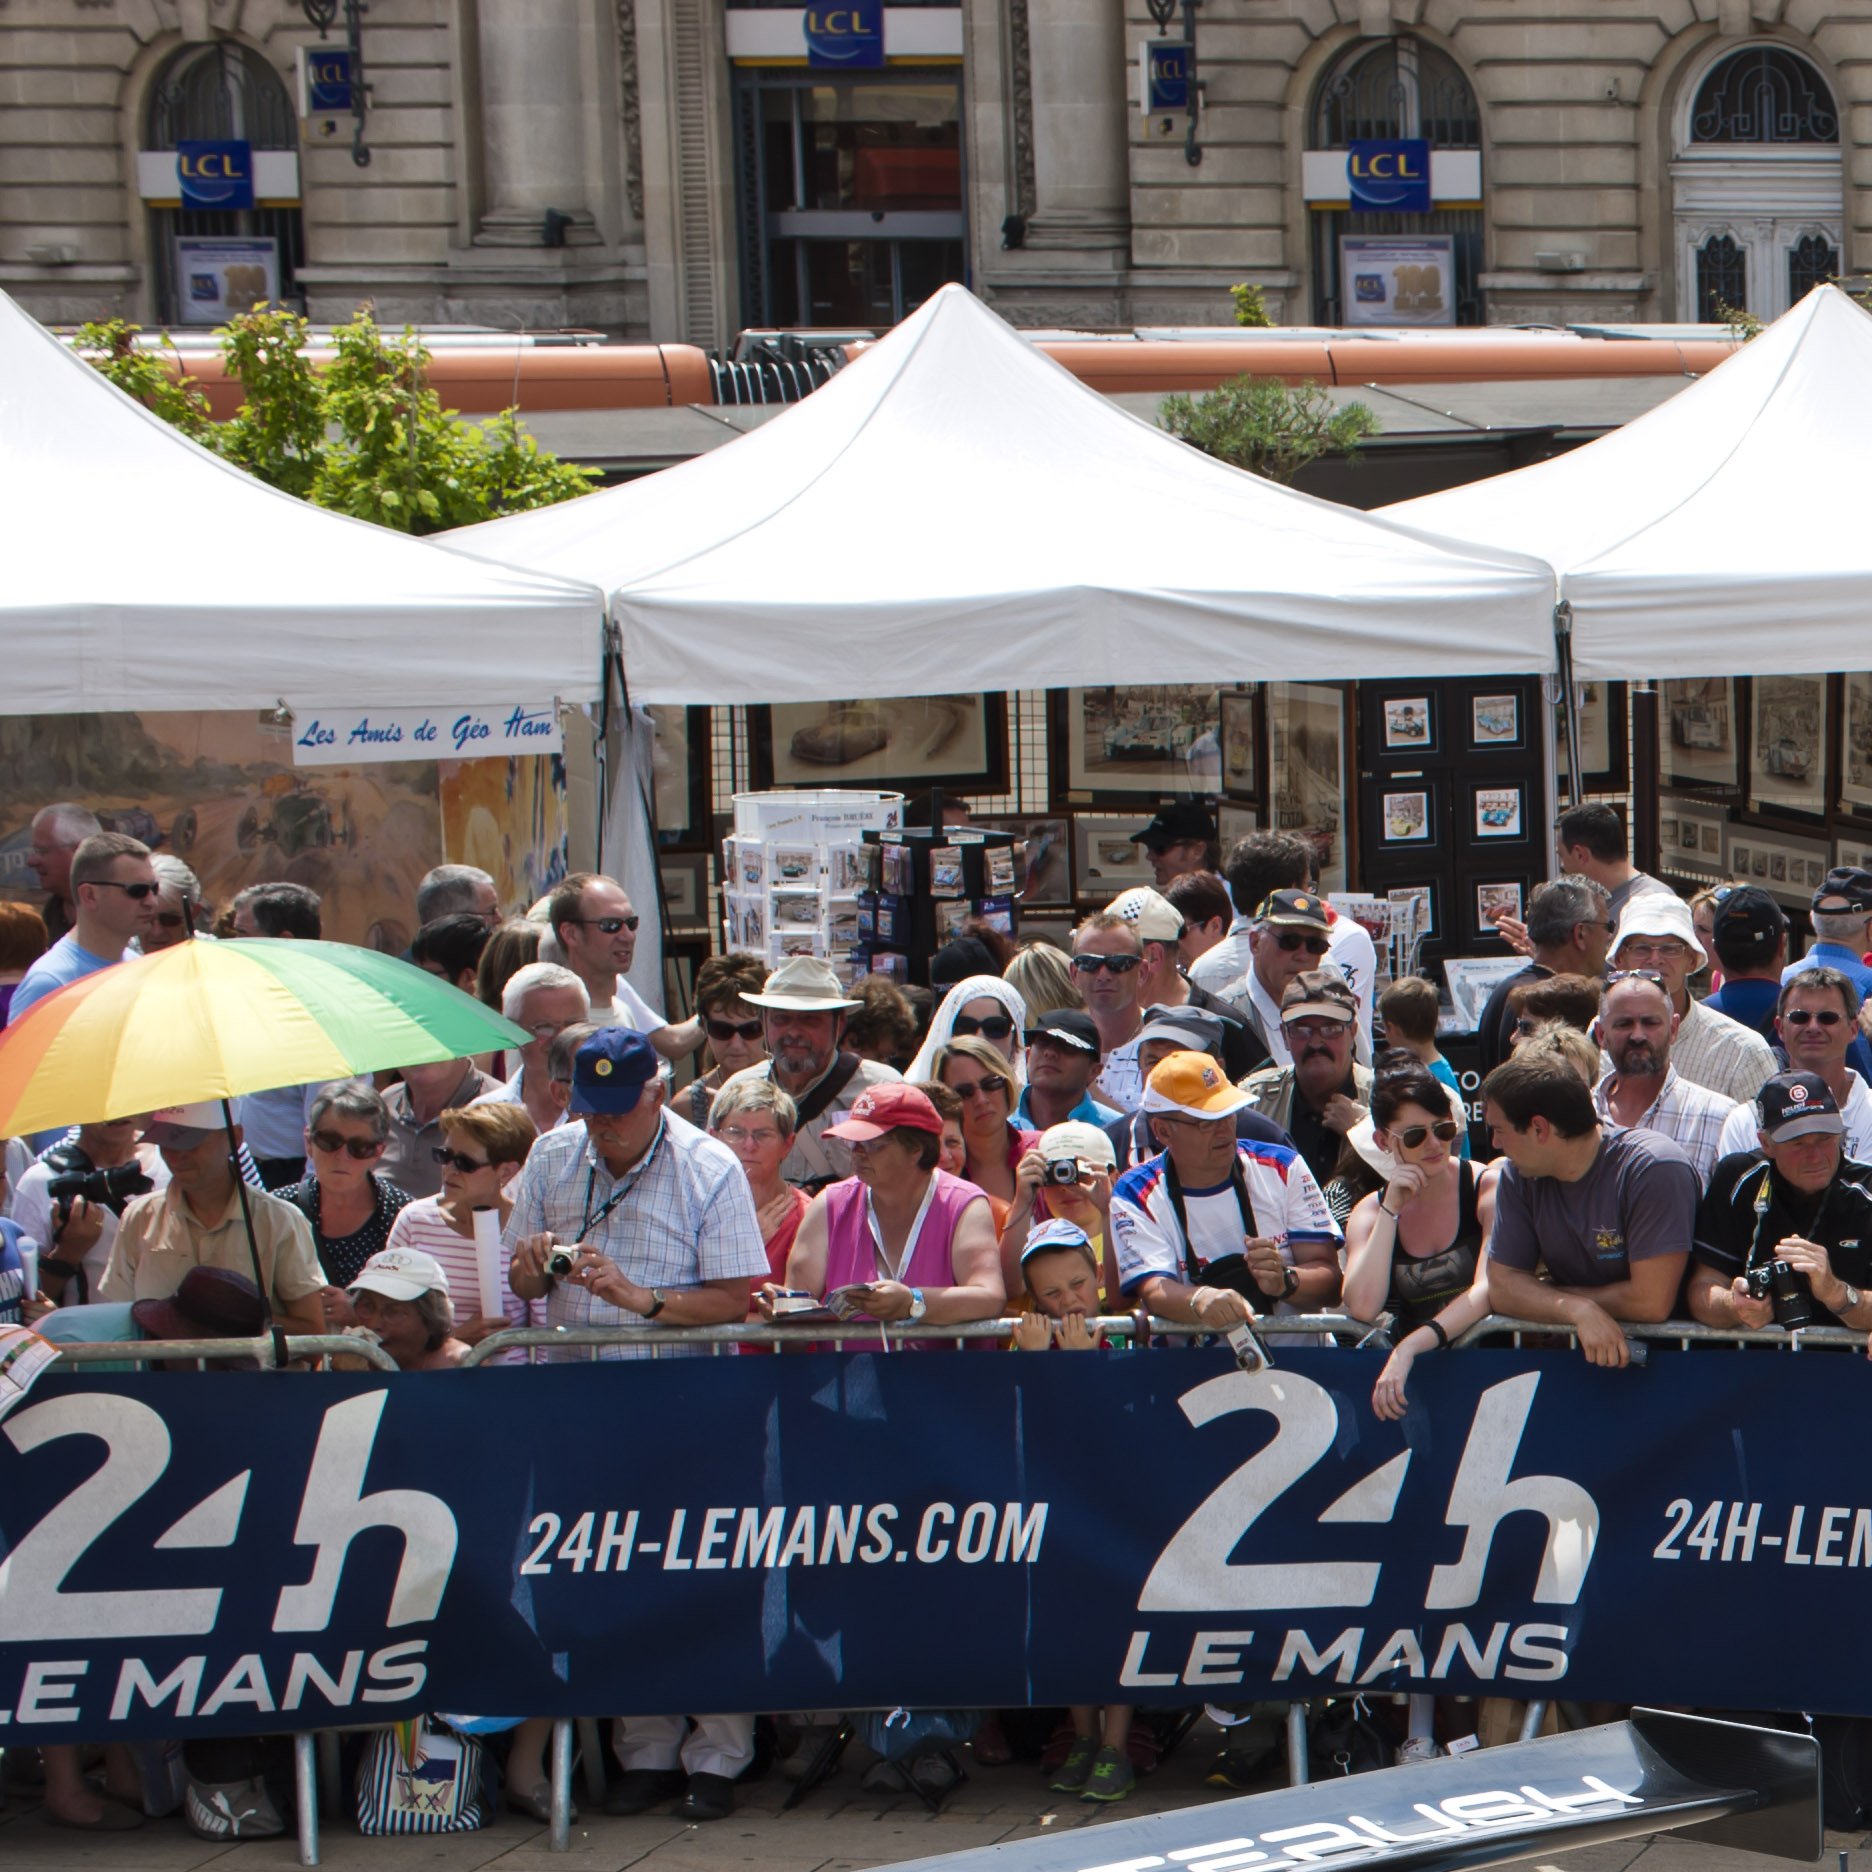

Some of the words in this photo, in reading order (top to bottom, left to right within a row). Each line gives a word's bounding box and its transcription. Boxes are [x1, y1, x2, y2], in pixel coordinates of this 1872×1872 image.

[809, 11, 871, 33] LCL
[181, 155, 243, 177] LCL
[1352, 154, 1419, 177] LCL
[297, 718, 335, 748] Les
[347, 716, 402, 745] Amis
[413, 715, 438, 742] de
[451, 714, 491, 751] Géo
[504, 704, 554, 737] Ham
[0, 1388, 458, 1642] 24h
[1137, 1370, 1601, 1612] 24h
[520, 1501, 1048, 1576] 24H-LEMANS.COM
[110, 1639, 428, 1721] MANS
[1119, 1629, 1254, 1687] LE
[1272, 1621, 1570, 1687] MANS
